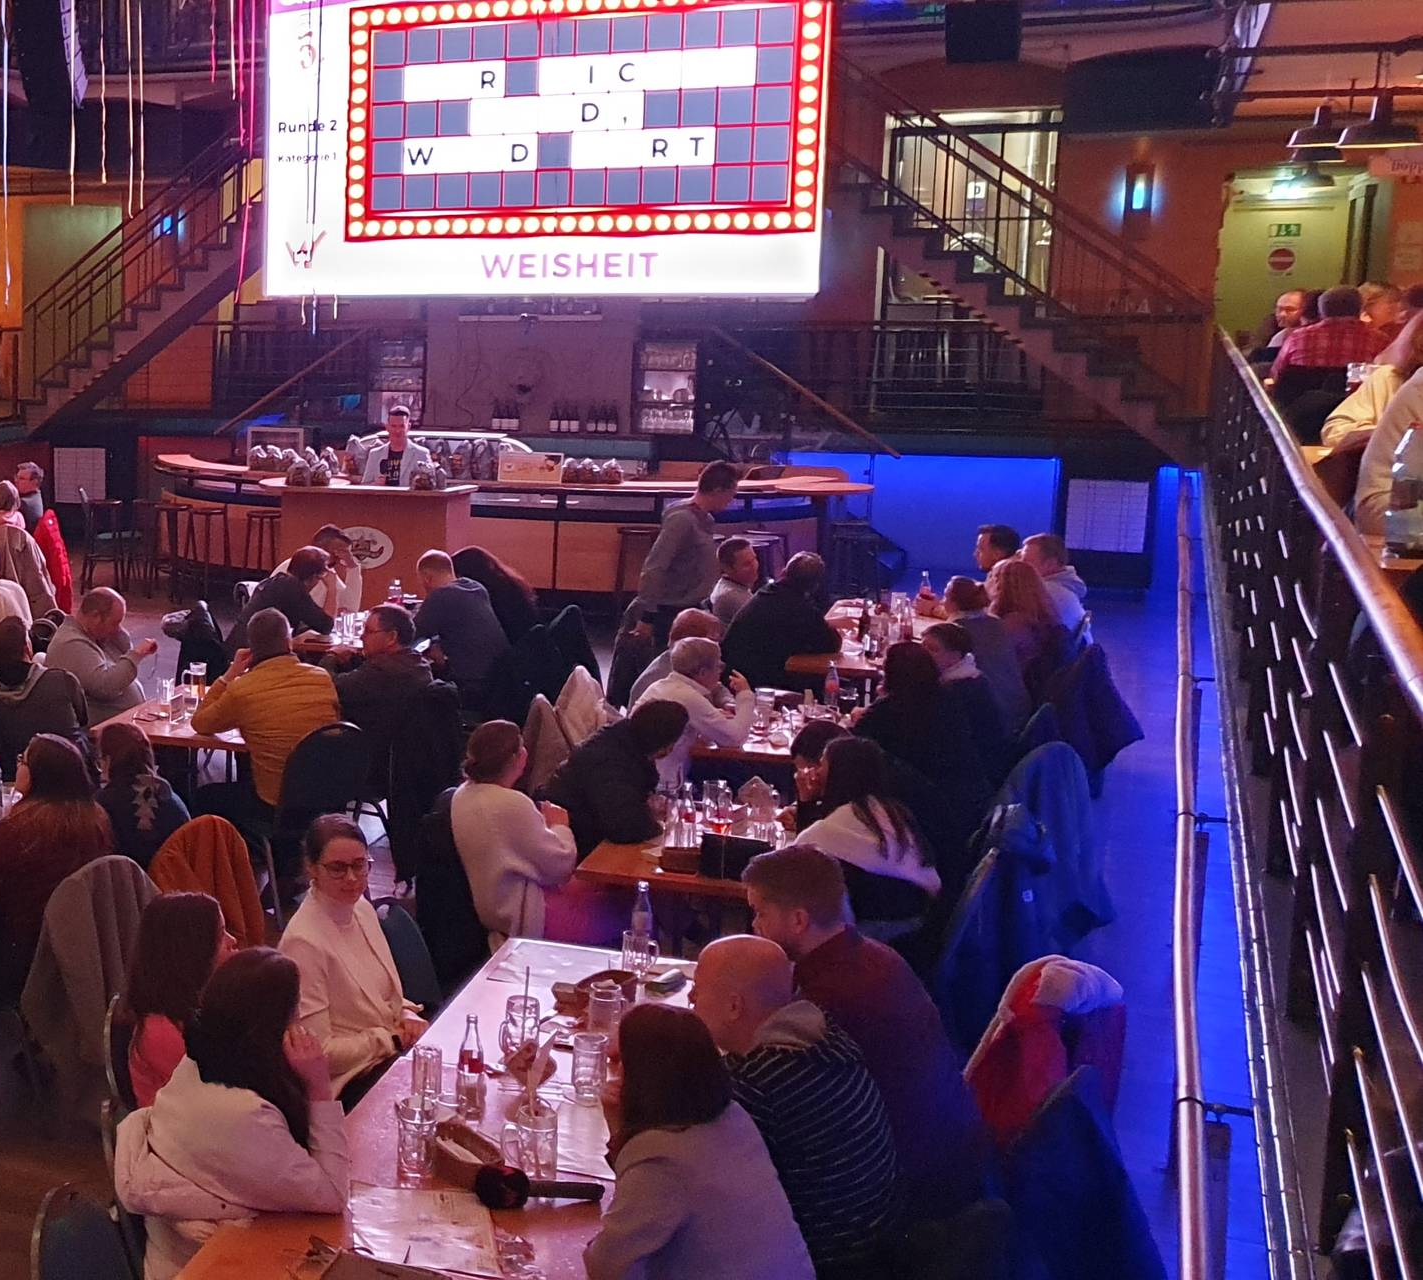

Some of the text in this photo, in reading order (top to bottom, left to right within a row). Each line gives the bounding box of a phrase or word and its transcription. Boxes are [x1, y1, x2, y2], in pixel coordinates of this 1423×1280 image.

[278, 120, 337, 133] Runde 2
[481, 253, 658, 278] WEISHEIT
